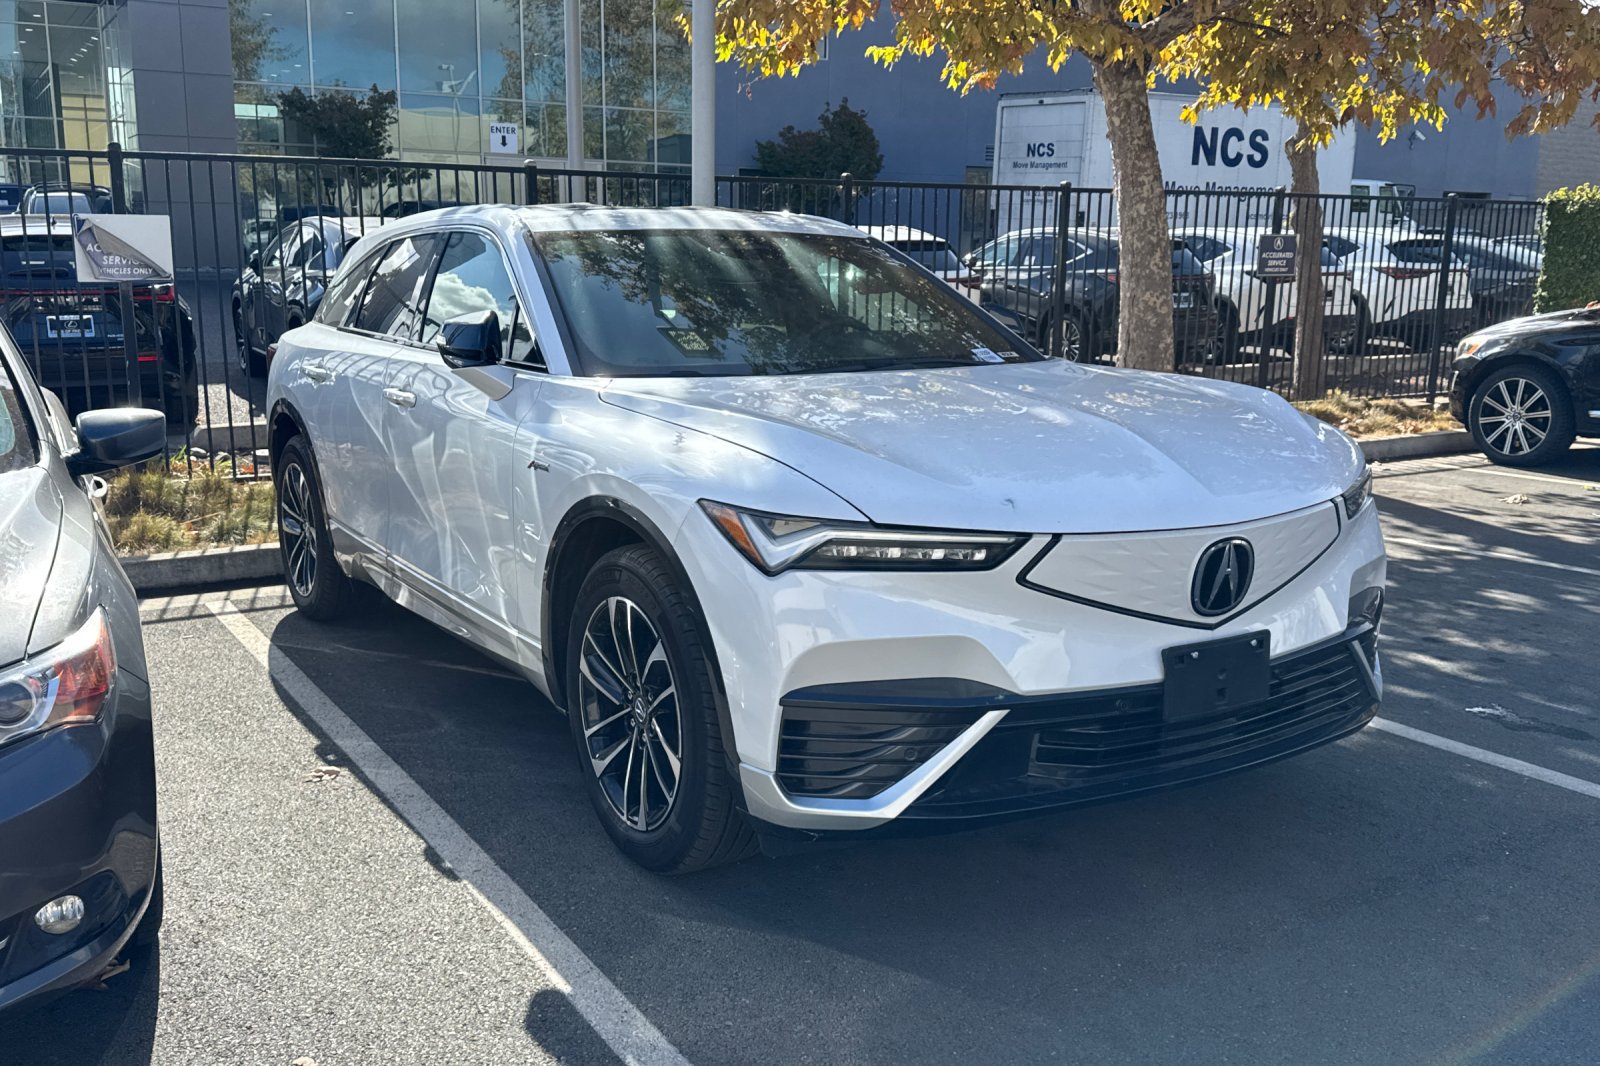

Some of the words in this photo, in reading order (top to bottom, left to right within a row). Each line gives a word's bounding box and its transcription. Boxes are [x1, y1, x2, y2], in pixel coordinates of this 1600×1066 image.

[490, 125, 516, 135] ENTER
[1026, 142, 1055, 158] NCS
[1191, 126, 1269, 168] NCS
[1013, 161, 1028, 169] Move
[1030, 161, 1068, 170] Management
[102, 255, 145, 265] SERVIC
[132, 267, 153, 275] ONLY
